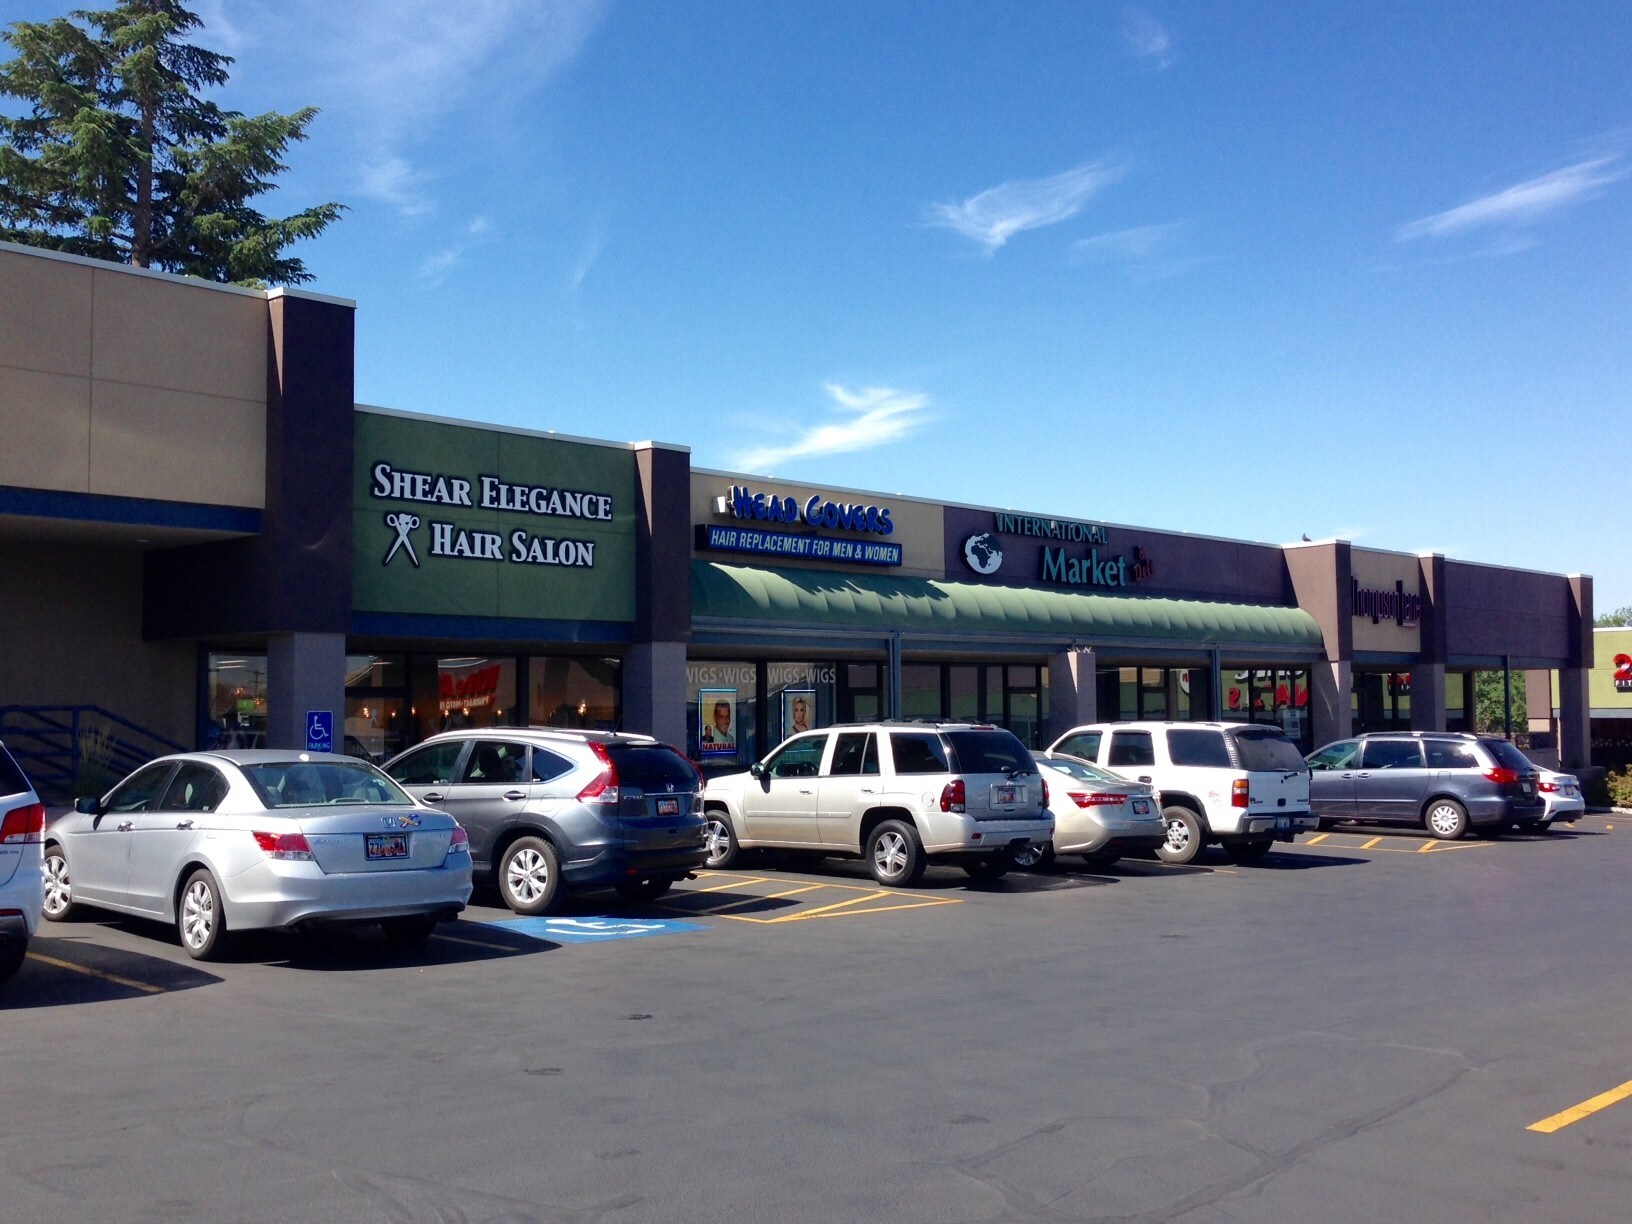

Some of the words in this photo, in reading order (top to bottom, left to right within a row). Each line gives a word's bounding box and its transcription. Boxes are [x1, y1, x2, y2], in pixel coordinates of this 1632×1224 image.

[373, 463, 472, 507] SHEAR
[480, 476, 612, 521] ELEGANCE
[728, 485, 798, 524] HEAD
[803, 494, 895, 536] COVERS
[431, 523, 504, 560] HAIR
[511, 531, 595, 567] SALON
[710, 529, 736, 548] HAIR
[739, 533, 811, 554] REPLACEMENT
[812, 540, 830, 557] FOR
[832, 542, 853, 559] MEN
[854, 545, 862, 559] &
[865, 545, 899, 563] WOMEN
[995, 512, 1108, 545] INTERNATIONAL
[1042, 546, 1126, 587] Market
[308, 742, 331, 750] PARKING
